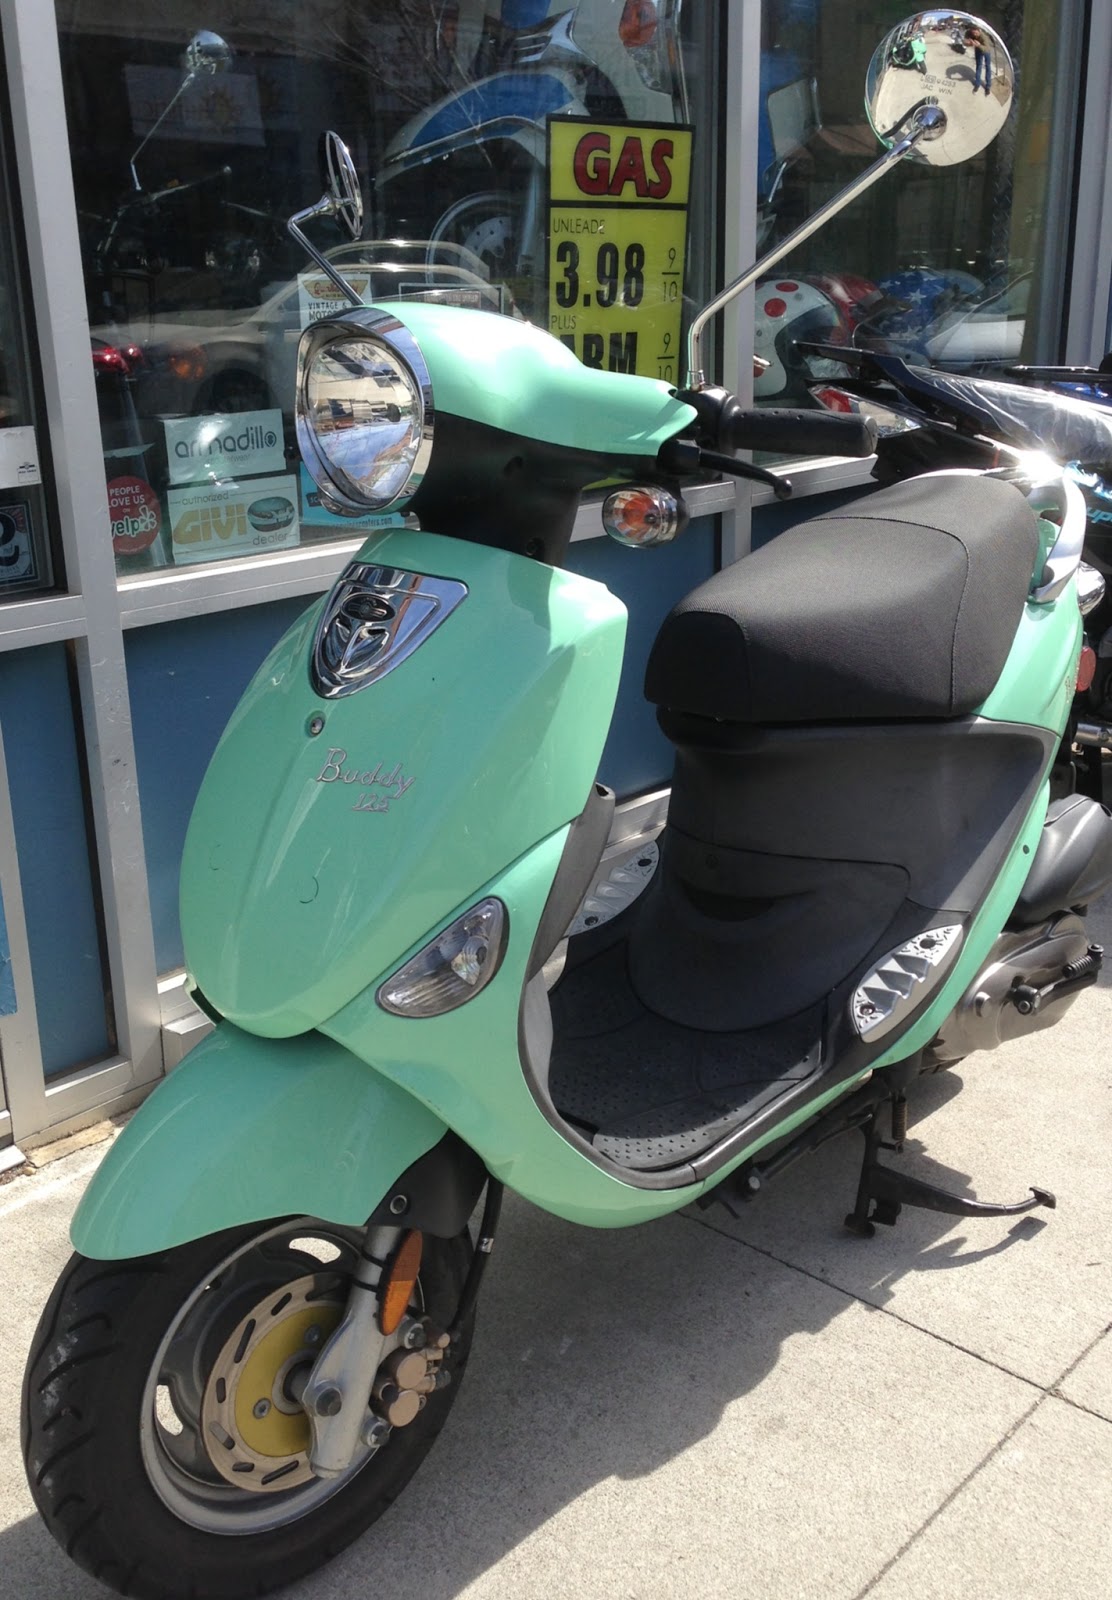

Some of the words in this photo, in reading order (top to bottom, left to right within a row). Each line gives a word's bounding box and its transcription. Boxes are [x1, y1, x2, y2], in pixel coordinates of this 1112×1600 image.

[573, 131, 675, 200] GAS
[556, 240, 646, 308] 3.98
[663, 280, 678, 303] 10
[308, 301, 339, 310] VINTAGE
[551, 315, 577, 330] PLUS
[174, 426, 277, 459] armadillo
[109, 485, 141, 497] PEOPLE
[181, 490, 230, 506] authorized
[109, 496, 131, 508] OVE
[133, 494, 146, 505] US
[173, 503, 247, 544] GIVI
[252, 532, 289, 547] dealer
[316, 747, 415, 799] Buddy
